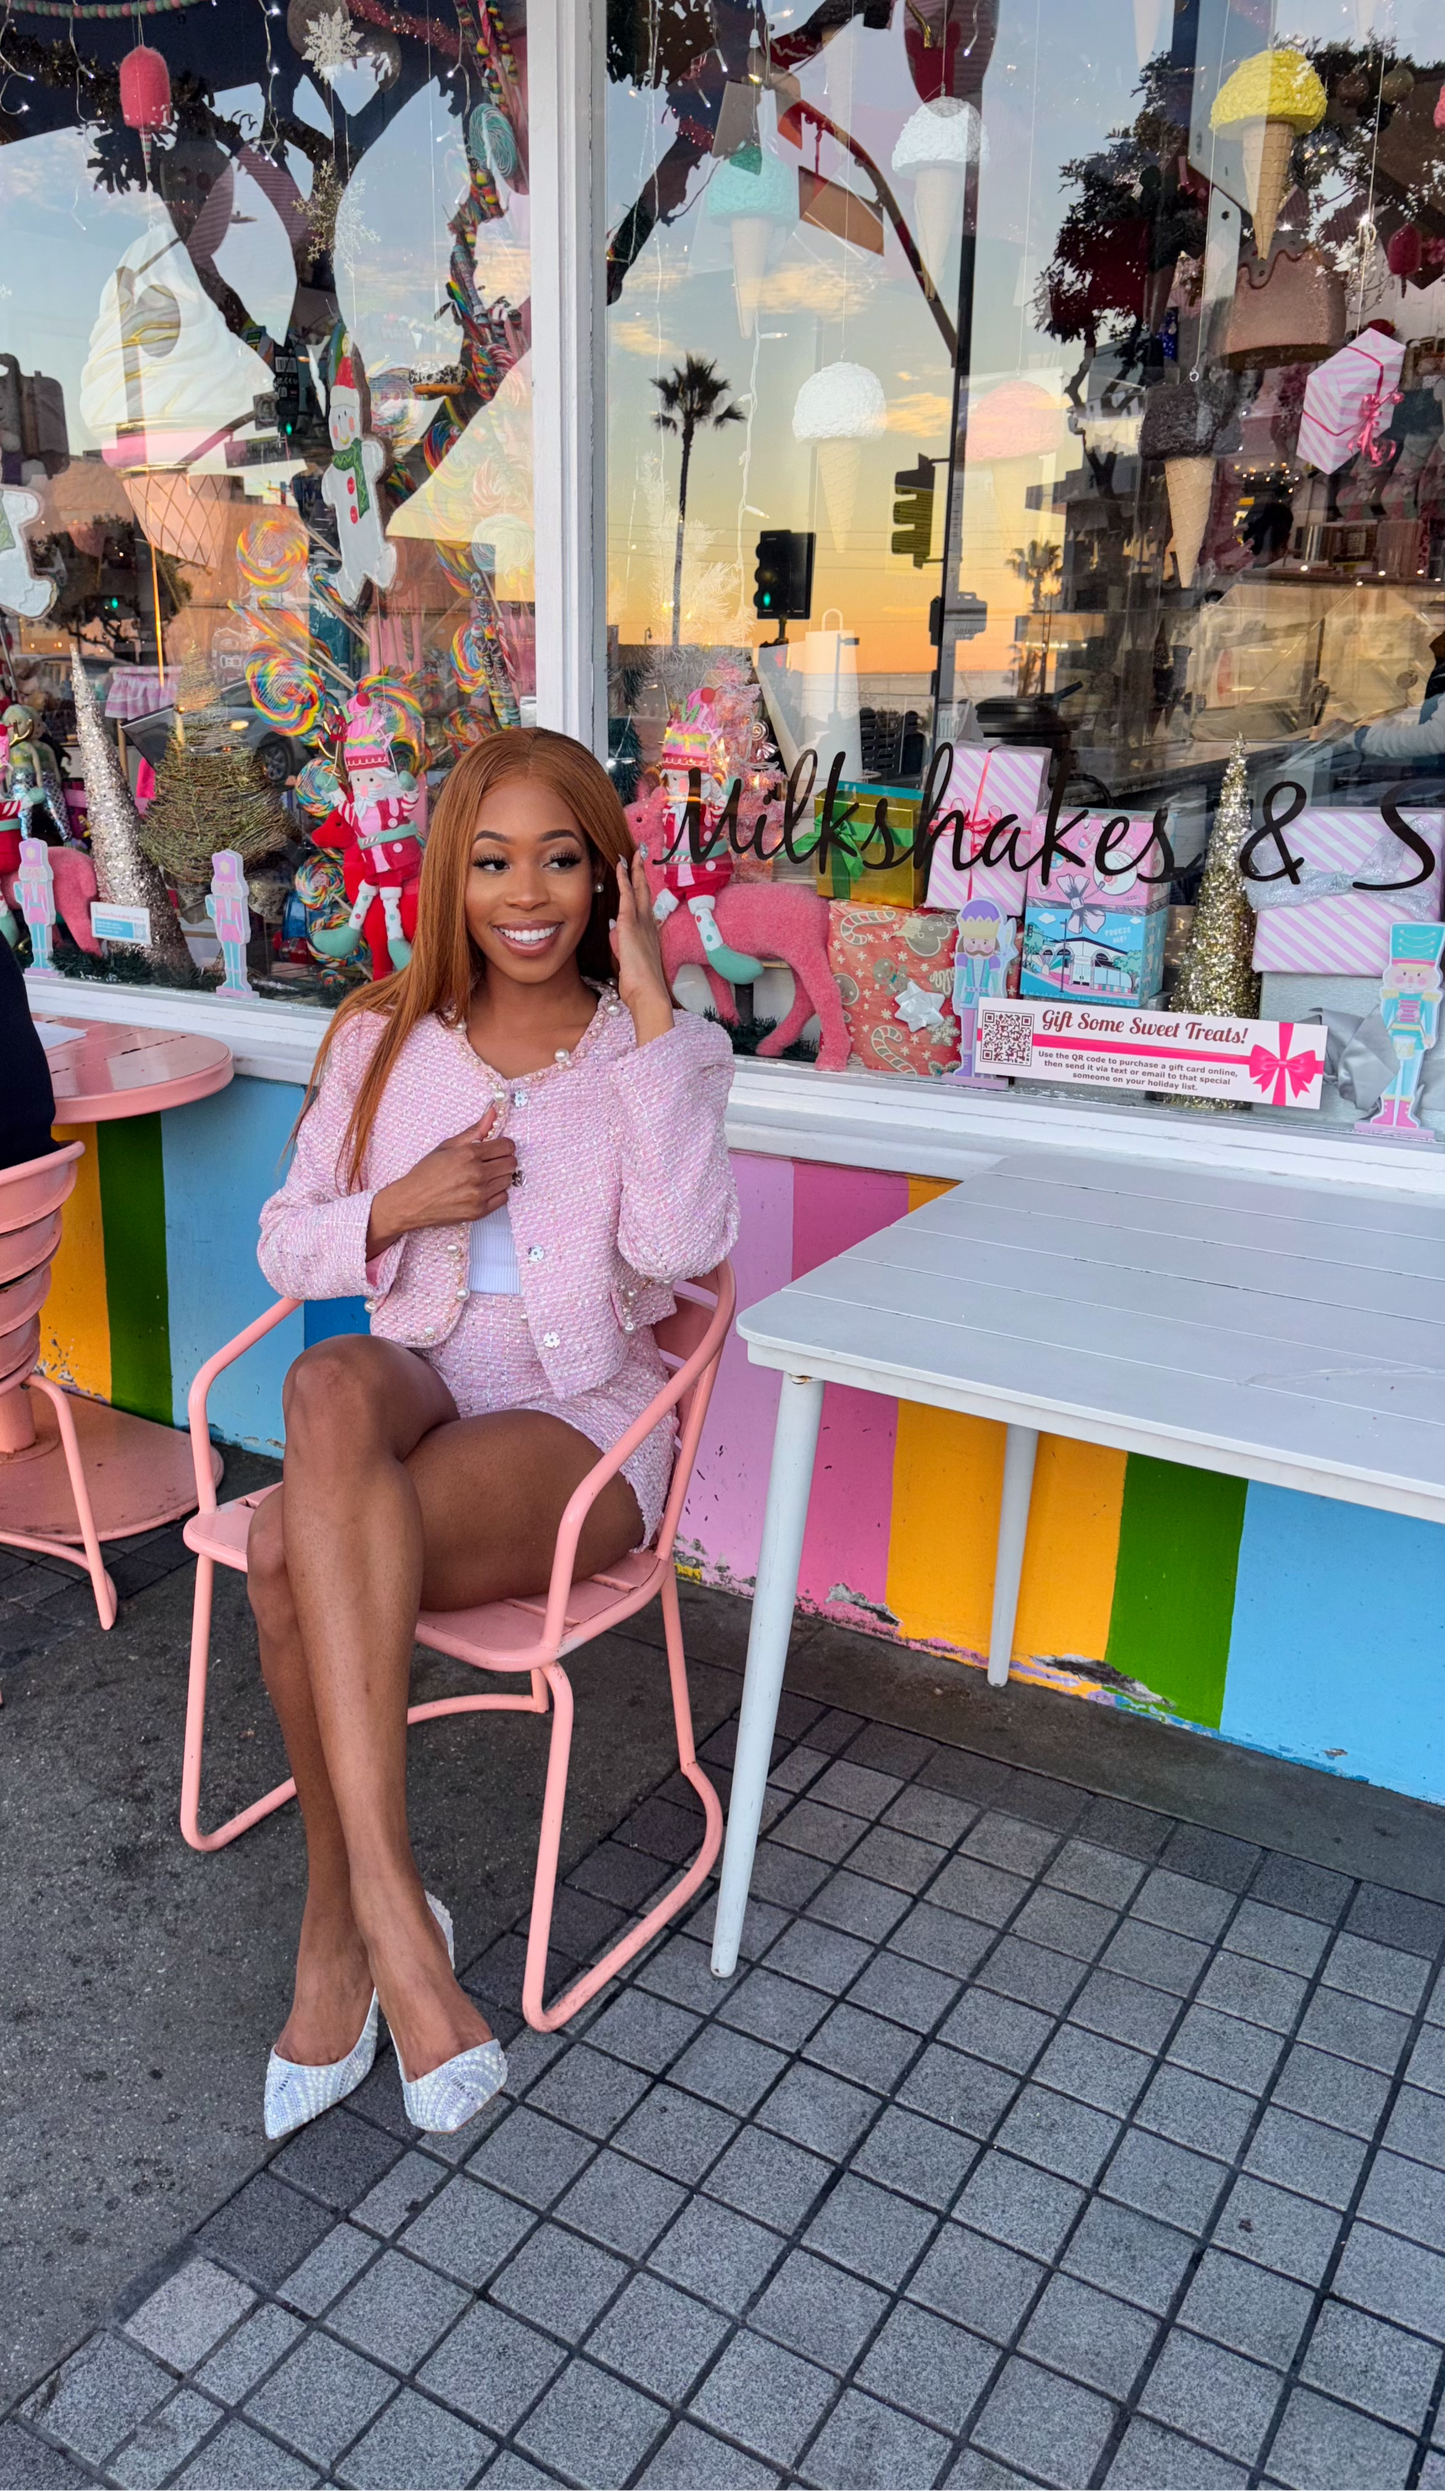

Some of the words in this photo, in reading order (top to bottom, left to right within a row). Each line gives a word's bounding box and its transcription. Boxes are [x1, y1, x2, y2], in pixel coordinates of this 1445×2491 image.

[652, 742, 1202, 886] Milkshakes
[1239, 781, 1305, 885] &
[1352, 778, 1445, 891] S
[1042, 1009, 1074, 1032] Gift
[1077, 1012, 1125, 1033] Some
[1129, 1017, 1181, 1038] Sweet
[1185, 1022, 1249, 1044] Treats!
[1038, 1050, 1054, 1058] Use
[1055, 1052, 1070, 1060] the
[1071, 1054, 1084, 1062] QR
[1086, 1056, 1106, 1064] code
[1119, 1060, 1159, 1069] purchase
[1169, 1064, 1184, 1072] gift
[1208, 1068, 1238, 1078] online,
[1044, 1060, 1063, 1068] then
[1096, 1065, 1108, 1073] via
[1111, 1067, 1128, 1075] text
[1141, 1070, 1166, 1078] email
[1179, 1074, 1197, 1082] that
[1199, 1076, 1231, 1085] special
[1072, 1072, 1111, 1082] someone
[1147, 1079, 1179, 1090] holiday
[1181, 1082, 1198, 1091] list.
